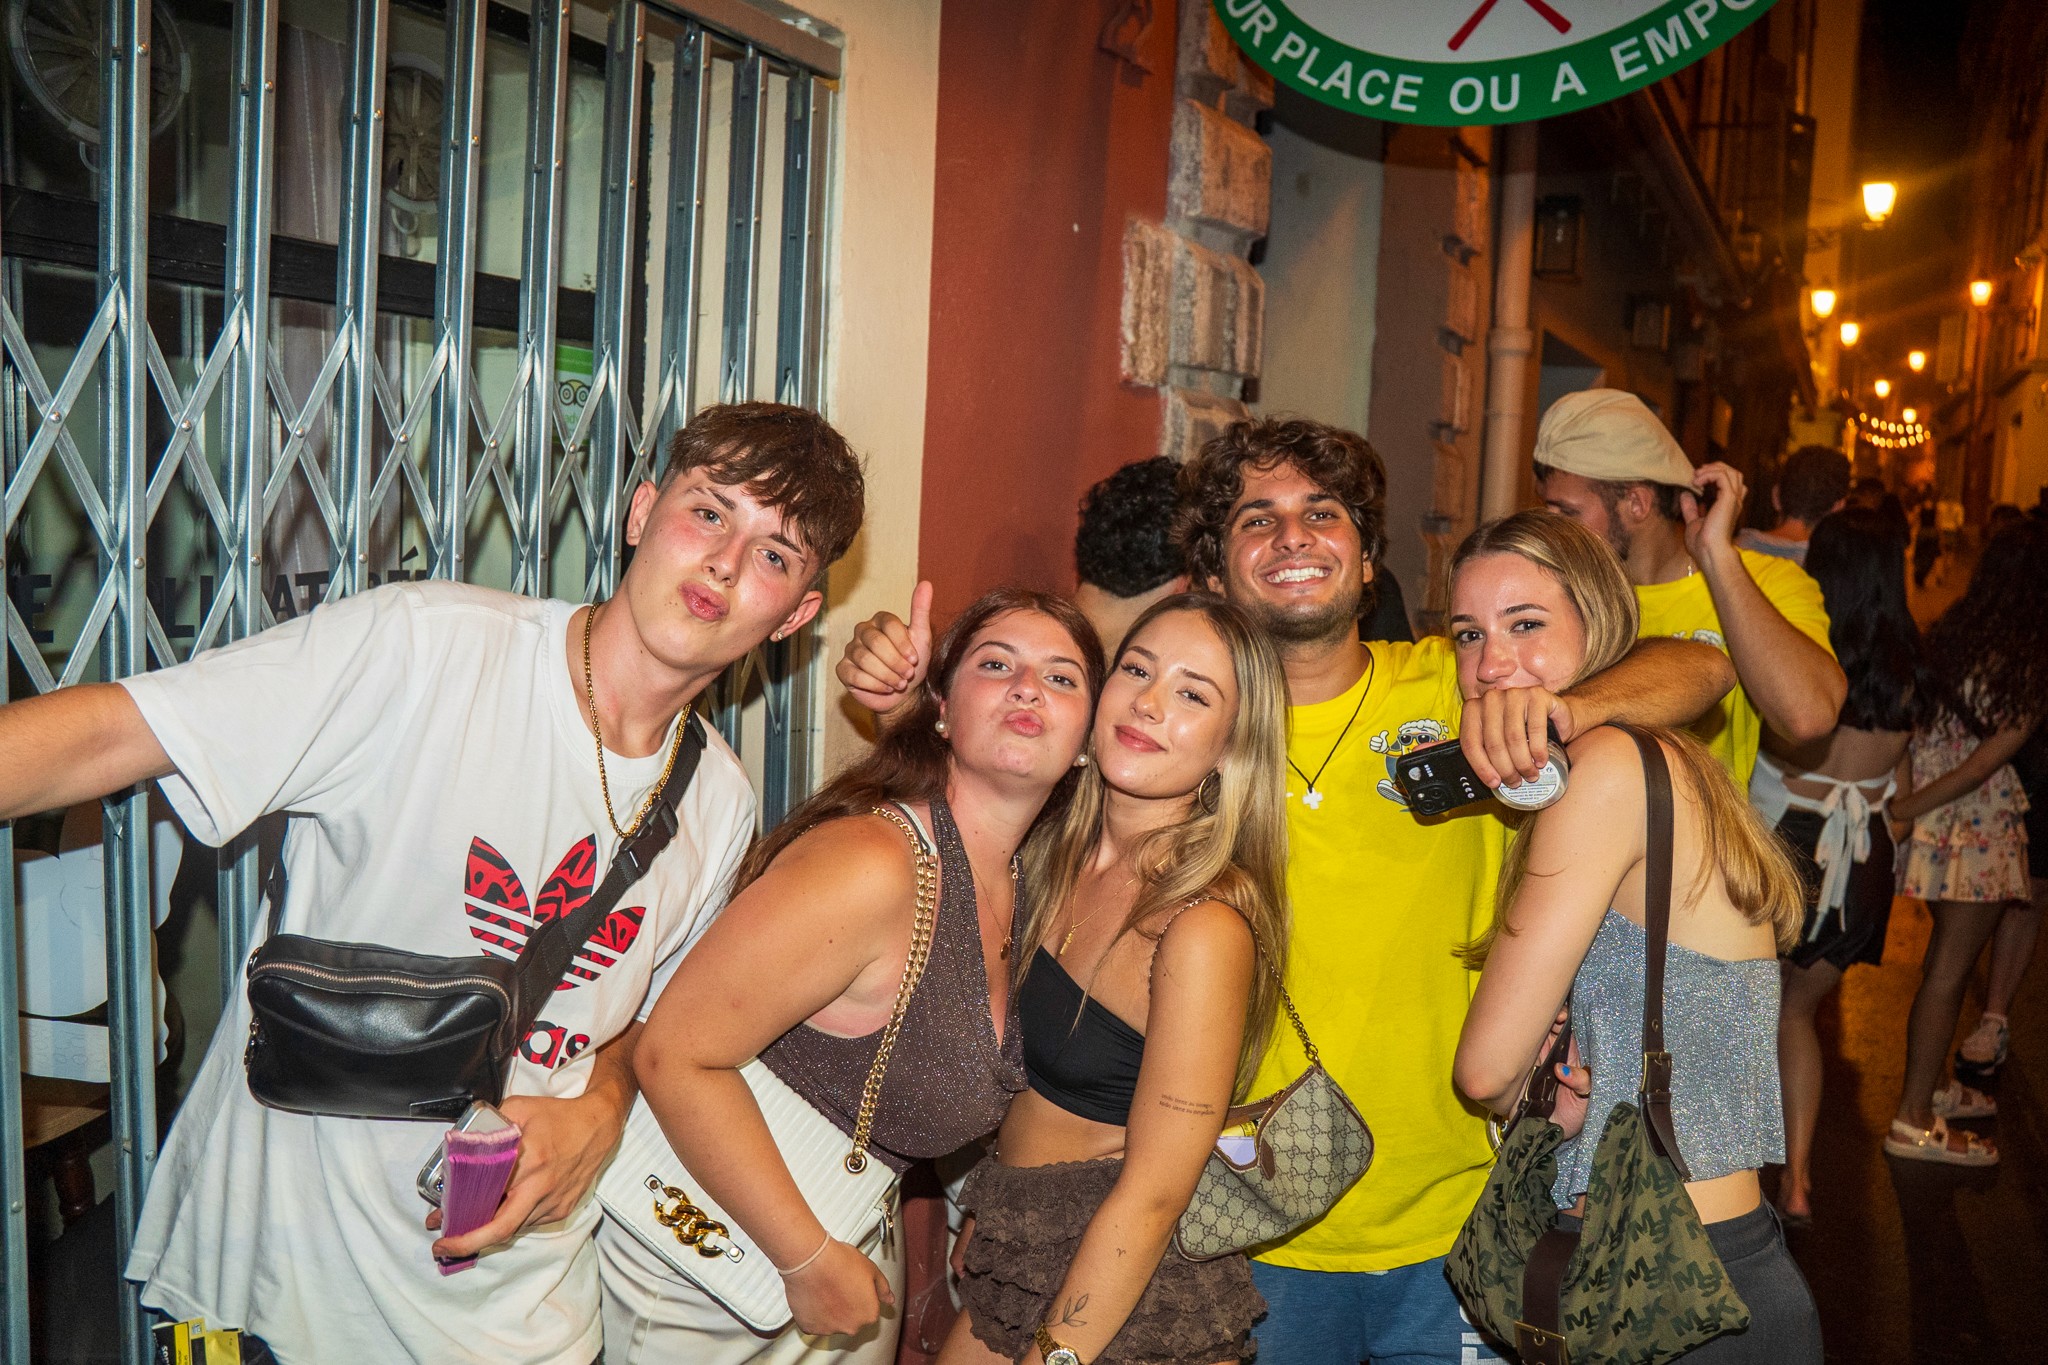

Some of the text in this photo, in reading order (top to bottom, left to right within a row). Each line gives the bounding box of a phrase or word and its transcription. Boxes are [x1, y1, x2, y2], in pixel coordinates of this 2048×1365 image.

[1271, 30, 1423, 112] PLACE
[1449, 74, 1520, 115] OU
[1551, 61, 1587, 102] A
